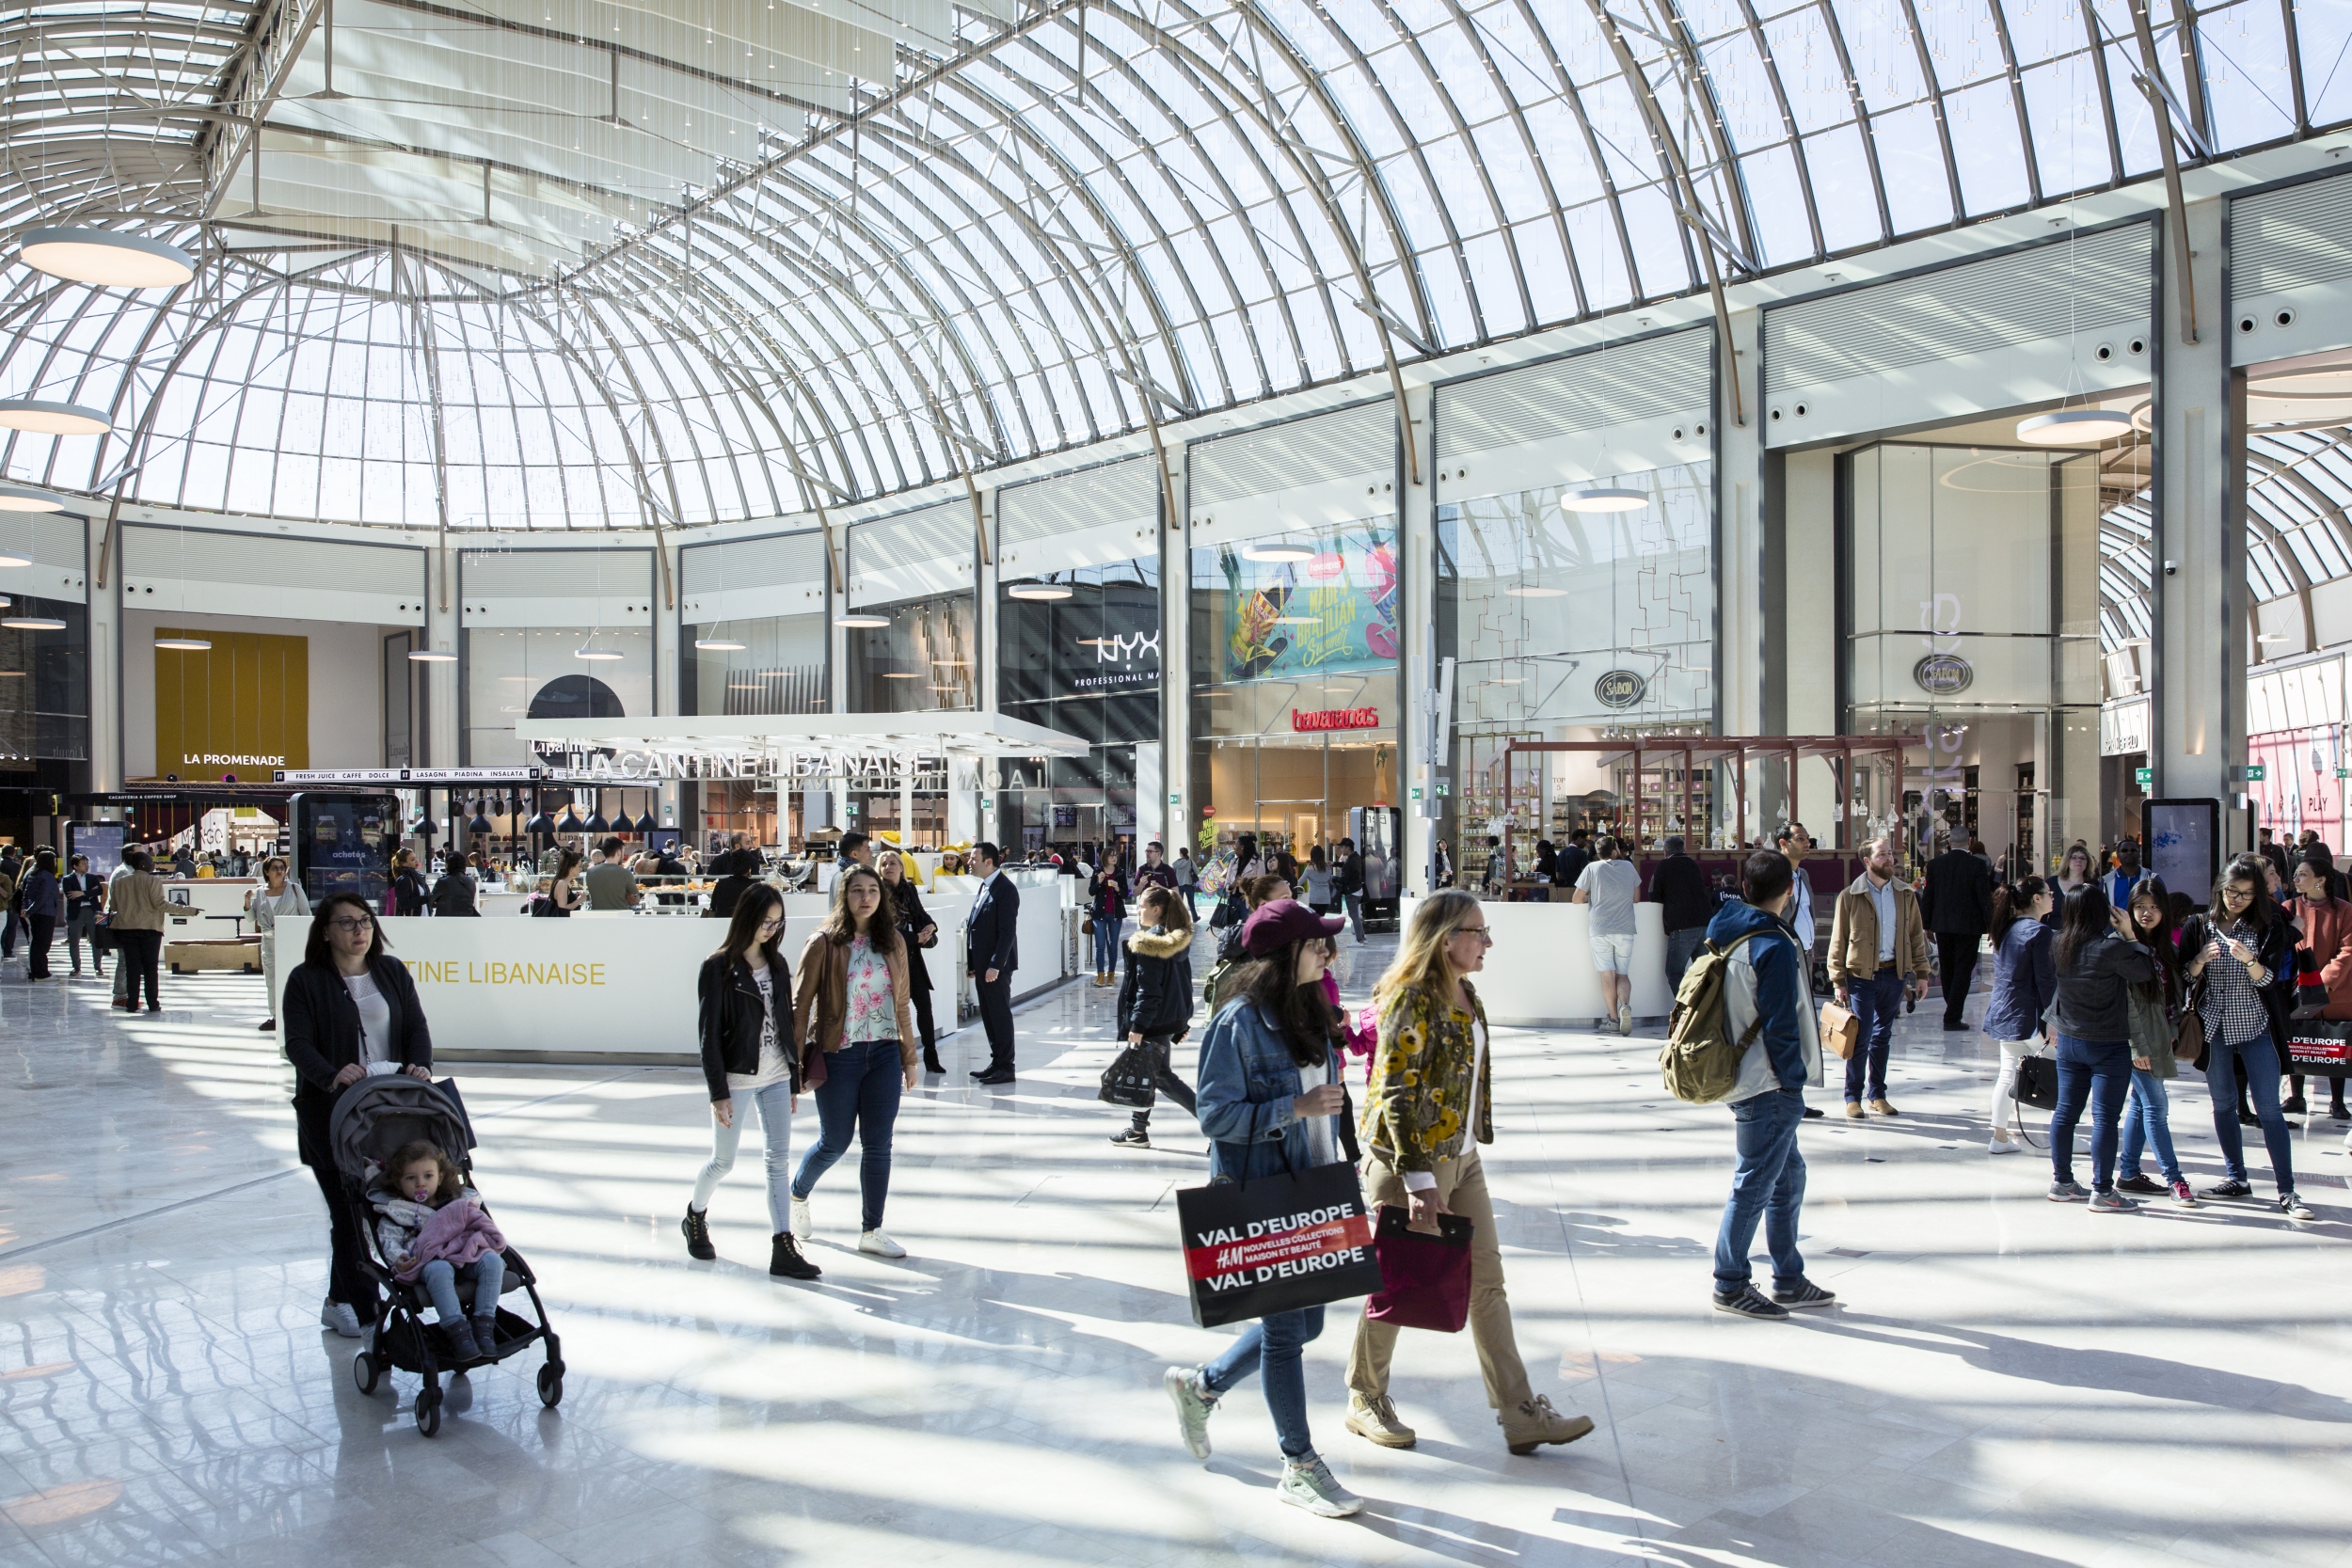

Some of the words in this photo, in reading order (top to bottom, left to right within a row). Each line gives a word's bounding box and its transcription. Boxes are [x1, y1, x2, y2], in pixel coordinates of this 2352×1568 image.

[1309, 581, 1339, 616] MADE
[1296, 596, 1356, 648] BRAZILIAN
[1097, 629, 1159, 663] NYX
[1303, 626, 1353, 667] Summer
[1074, 673, 1143, 687] PROFESSIONAL
[1292, 706, 1378, 732] havaianas
[183, 753, 200, 765] LA
[203, 754, 285, 766] PROMENADE
[571, 753, 614, 779] LA
[621, 752, 757, 779] CANTINE
[770, 750, 932, 778] LIBANAISE
[2309, 797, 2328, 812] PLAY
[469, 961, 606, 986] LIBANAISE
[2293, 1037, 2346, 1046] D'EUROPE
[2292, 1054, 2346, 1065] D'EUROPE
[1197, 1226, 1244, 1247] VAL
[1247, 1202, 1355, 1239] D'EUROPE
[1243, 1236, 1292, 1254] NOUVELLES
[1291, 1226, 1345, 1244] COLLECTIONS
[1245, 1250, 1279, 1264] MAISON
[1279, 1247, 1290, 1258] ET
[1290, 1240, 1323, 1256] BEAUTÉ
[1205, 1271, 1253, 1292] VAL
[1255, 1245, 1365, 1283] D'EUROPE
[1216, 1244, 1245, 1270] H&M
